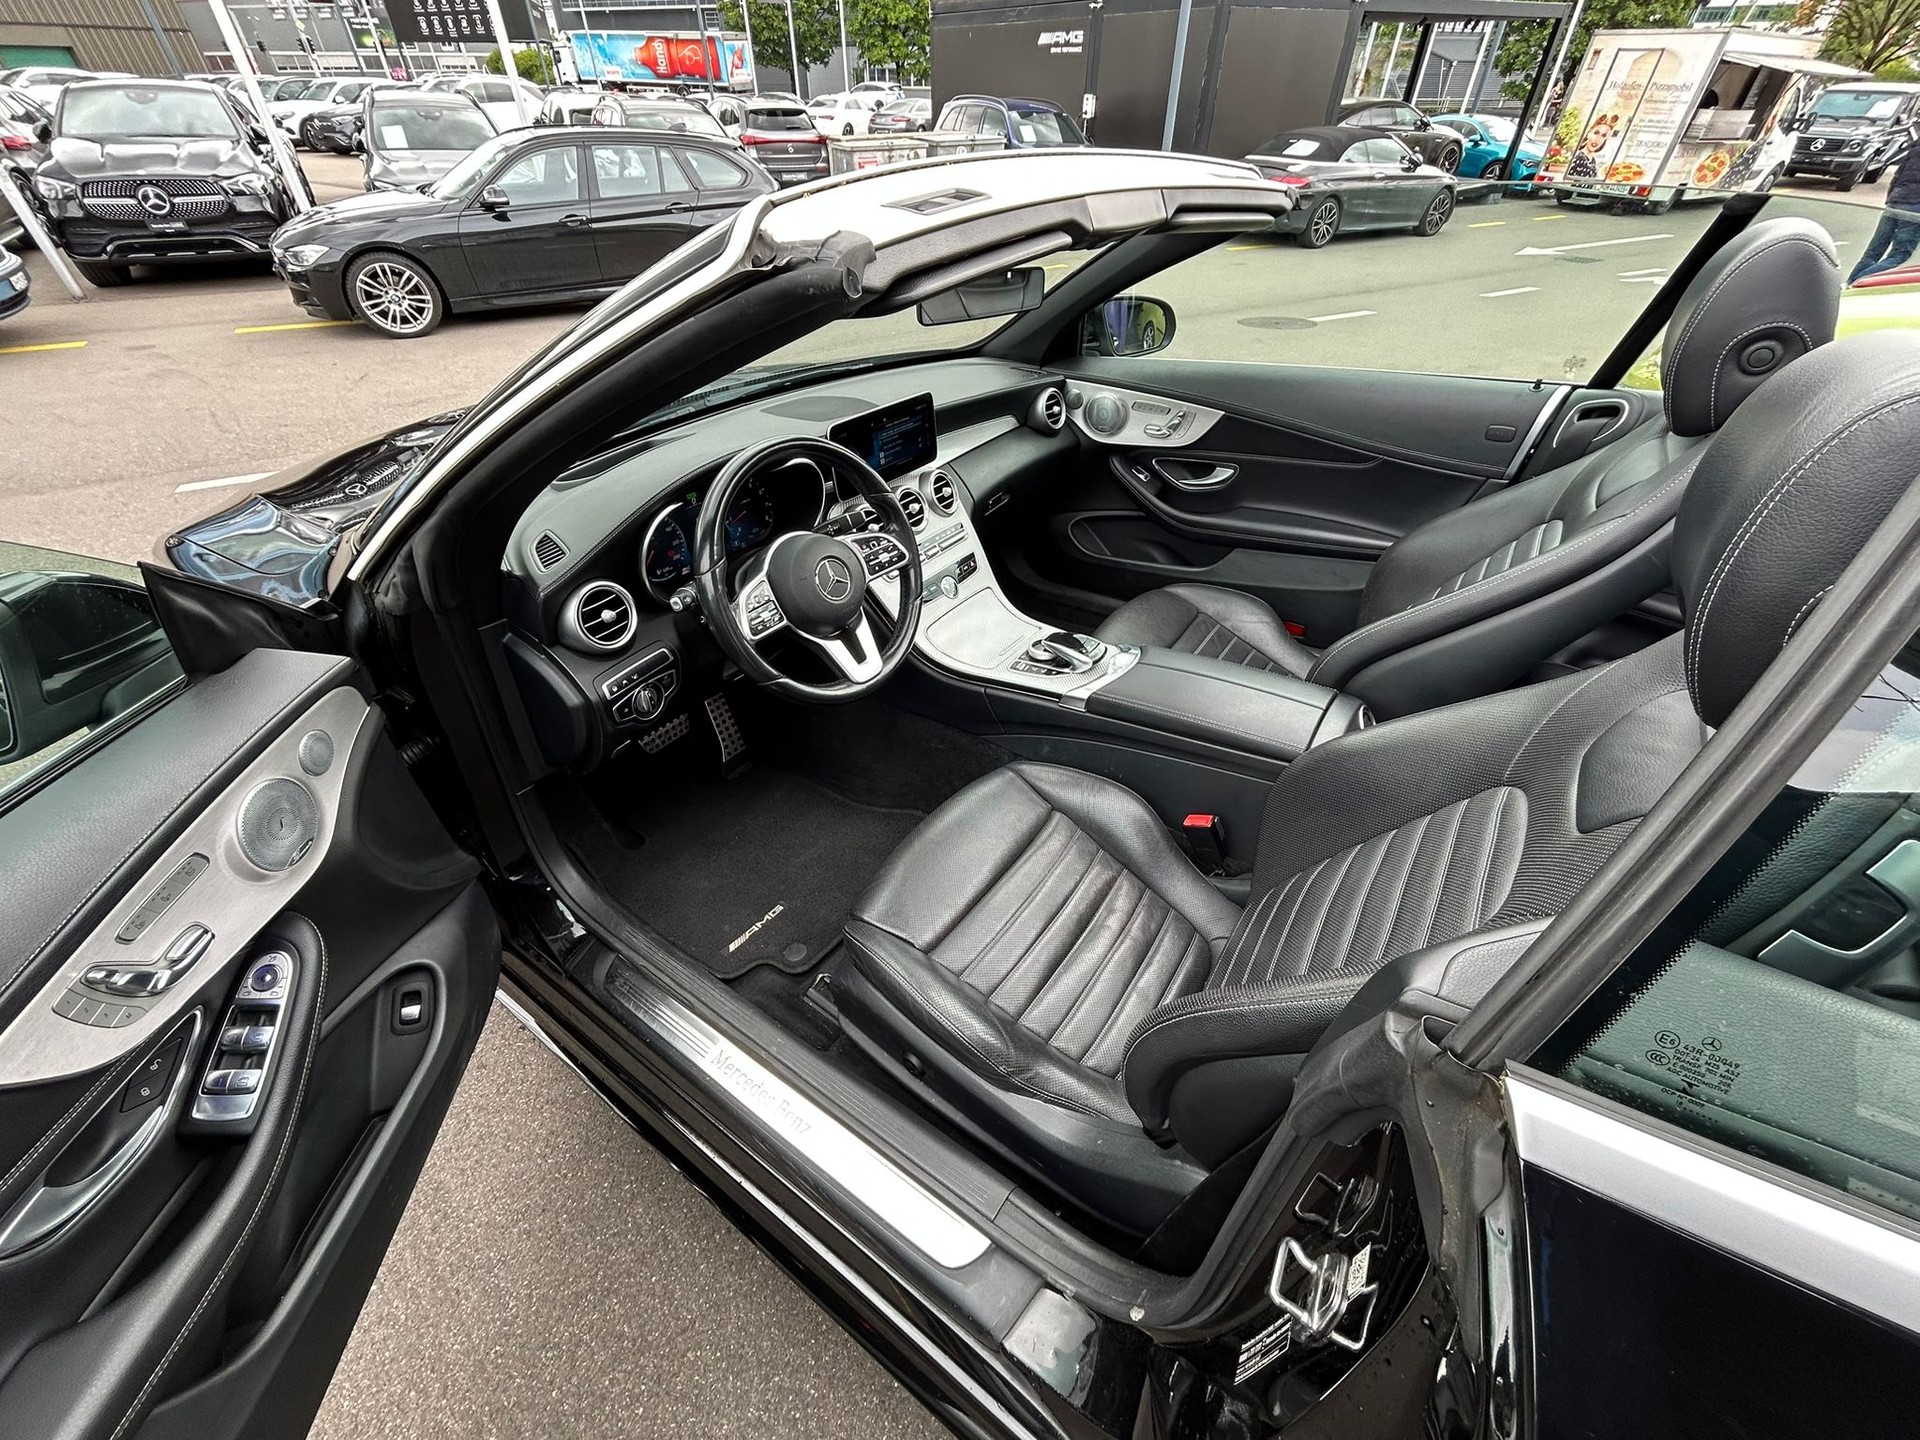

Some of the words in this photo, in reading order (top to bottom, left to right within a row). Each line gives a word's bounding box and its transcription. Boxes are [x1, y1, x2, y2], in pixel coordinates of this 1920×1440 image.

[1049, 30, 1084, 45] AMG
[652, 37, 668, 74] Handy
[740, 904, 784, 943] AMG
[1682, 1073, 1731, 1096] AUTOMOTIVE
